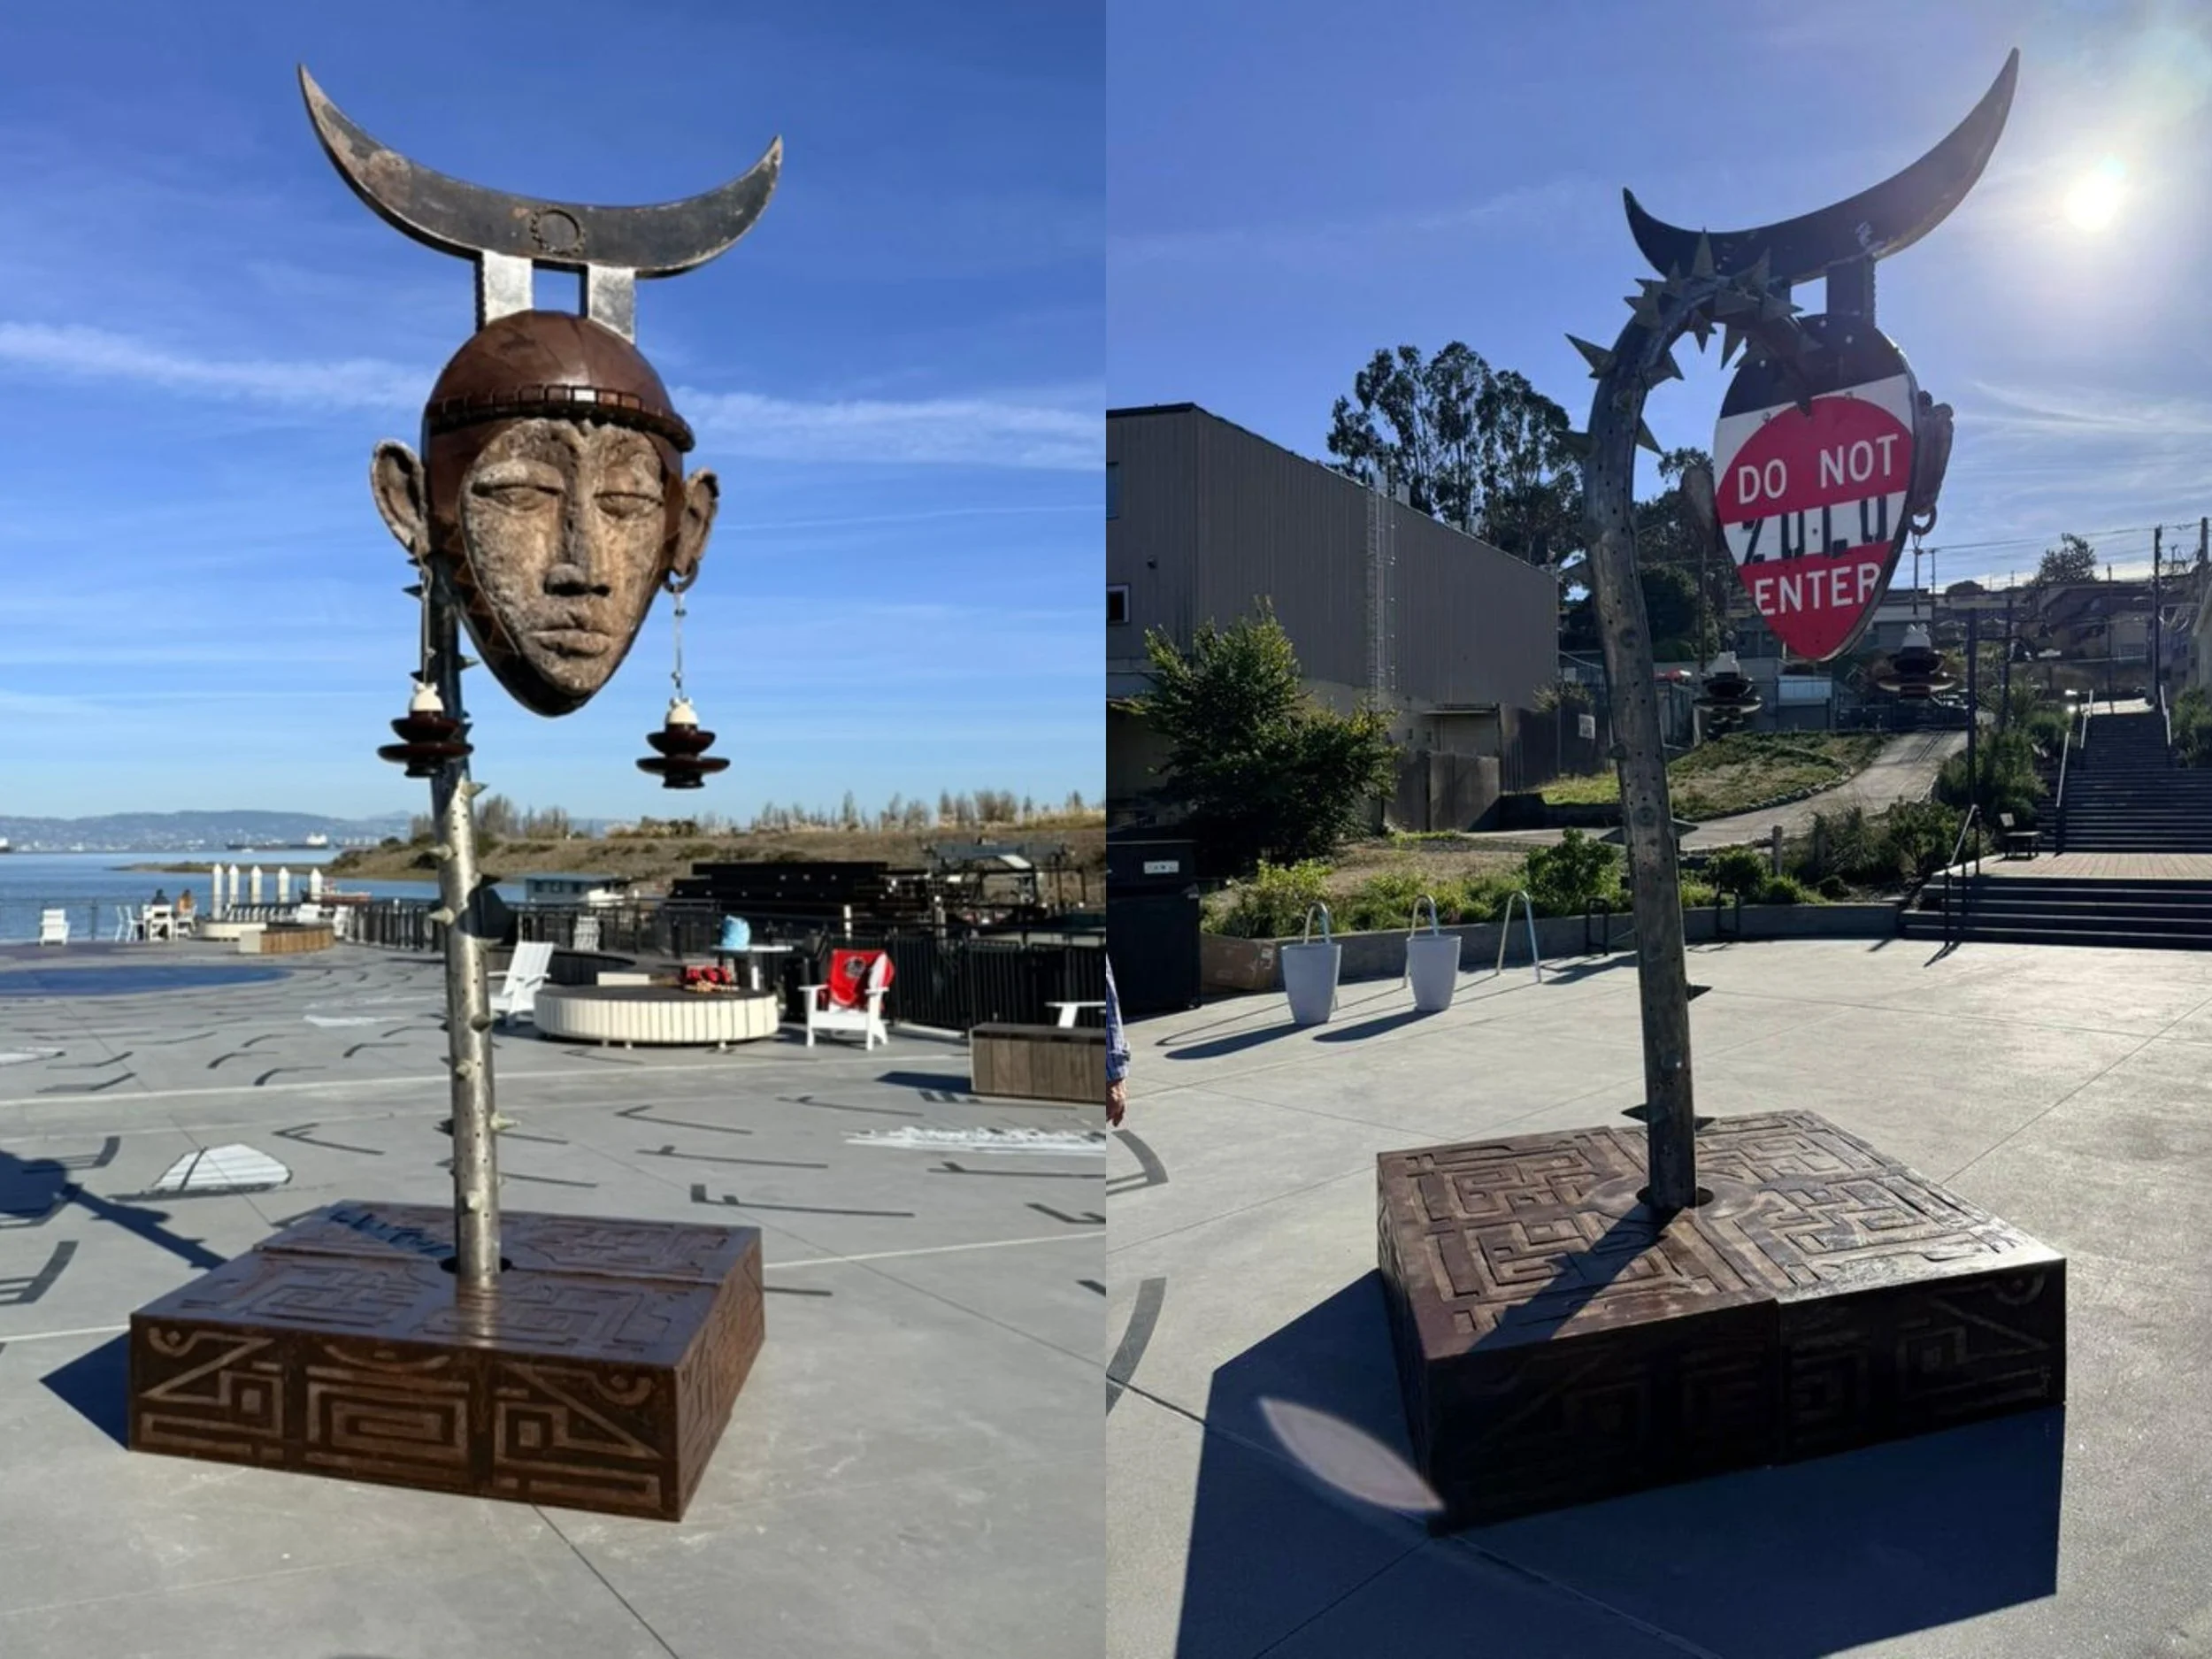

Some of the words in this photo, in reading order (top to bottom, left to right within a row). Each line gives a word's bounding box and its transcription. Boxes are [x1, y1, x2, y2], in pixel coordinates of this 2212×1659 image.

[1738, 458, 1787, 504] DO
[1820, 434, 1898, 488] NOT
[1755, 563, 1881, 616] ENTER
